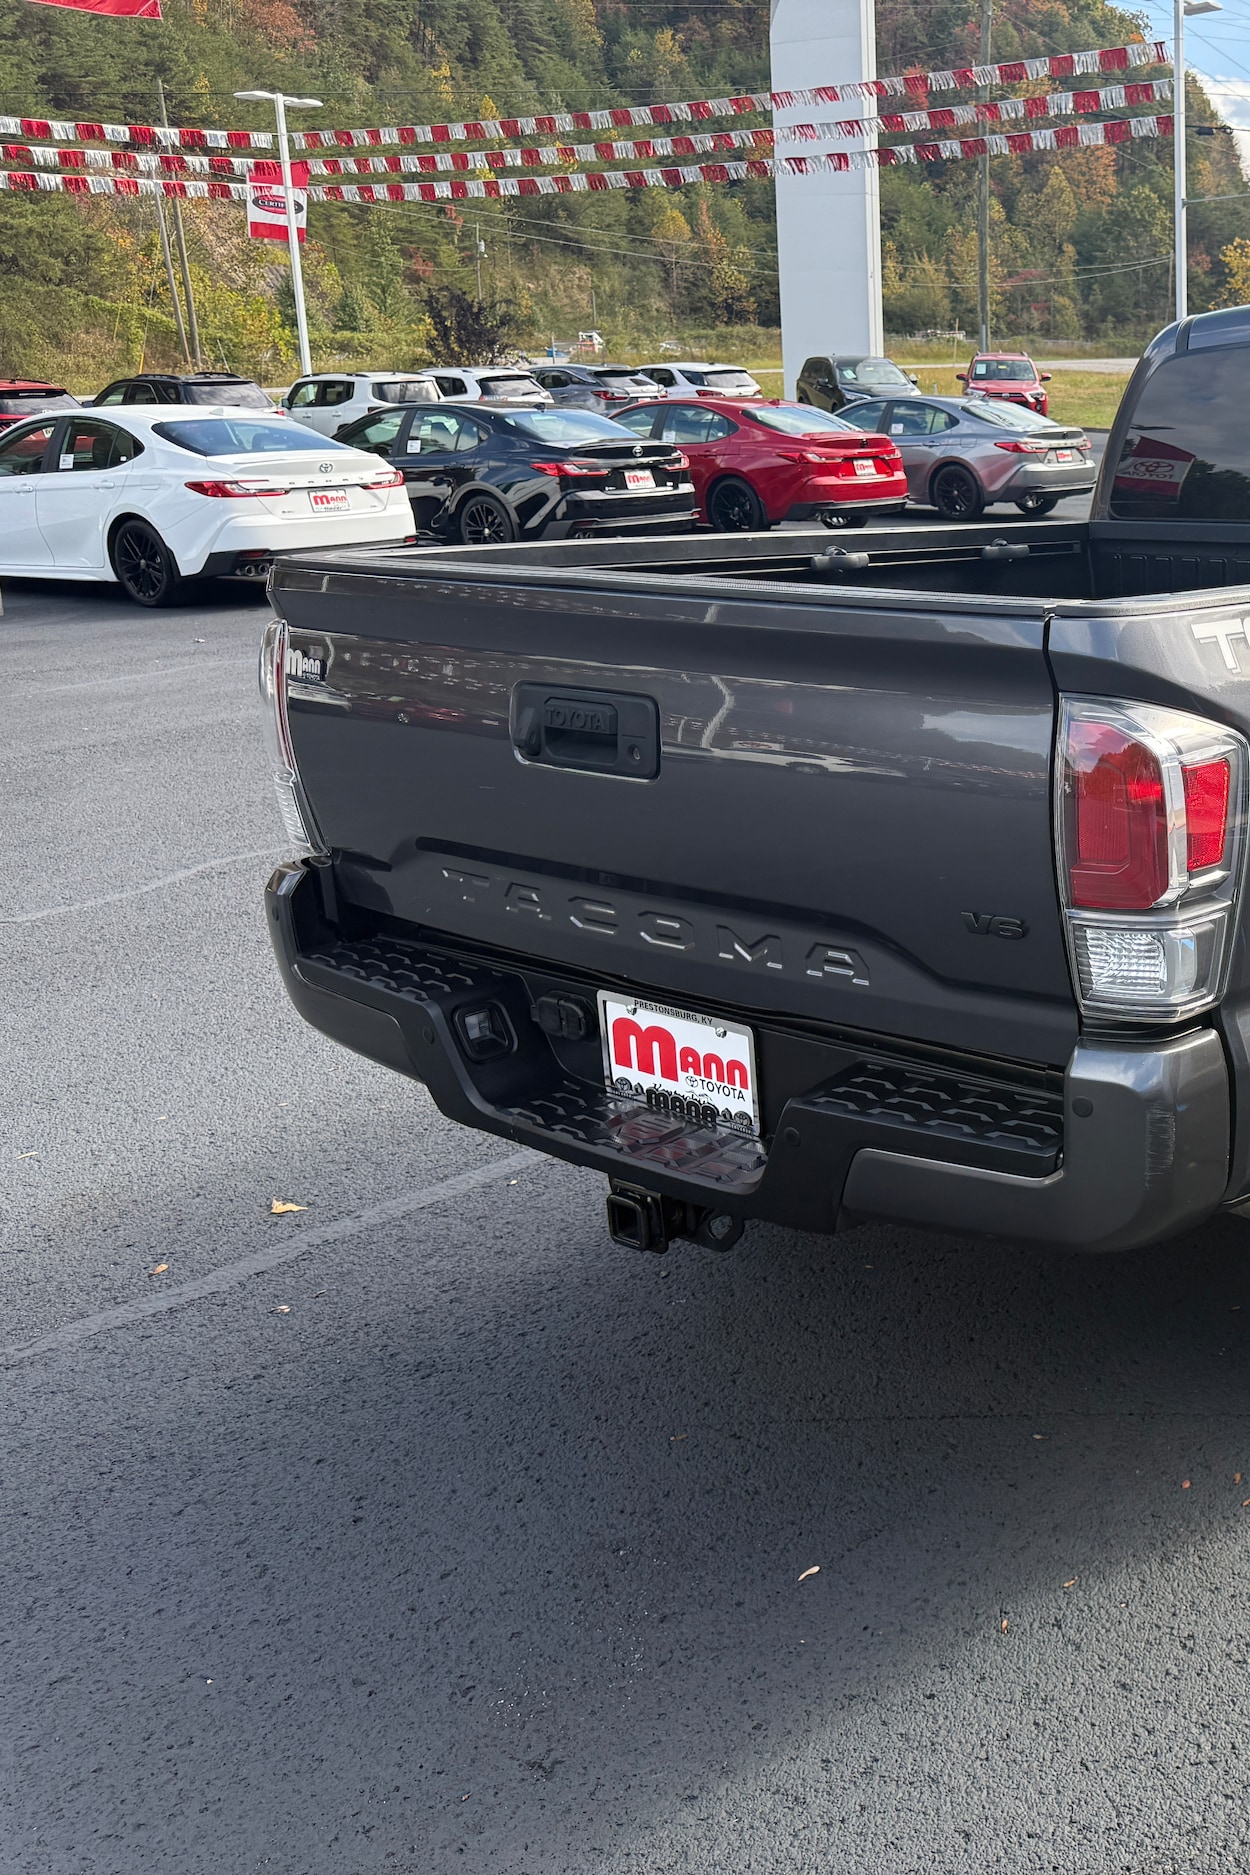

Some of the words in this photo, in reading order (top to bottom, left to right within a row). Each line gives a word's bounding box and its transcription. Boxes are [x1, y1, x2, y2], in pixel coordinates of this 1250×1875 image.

[546, 706, 606, 732] TOYOTA
[441, 867, 870, 986] TACOMA
[960, 910, 1027, 940] V6
[634, 999, 700, 1024] PRESTONSBURG,
[701, 1015, 714, 1026] KY
[699, 1078, 746, 1102] TOYOTA
